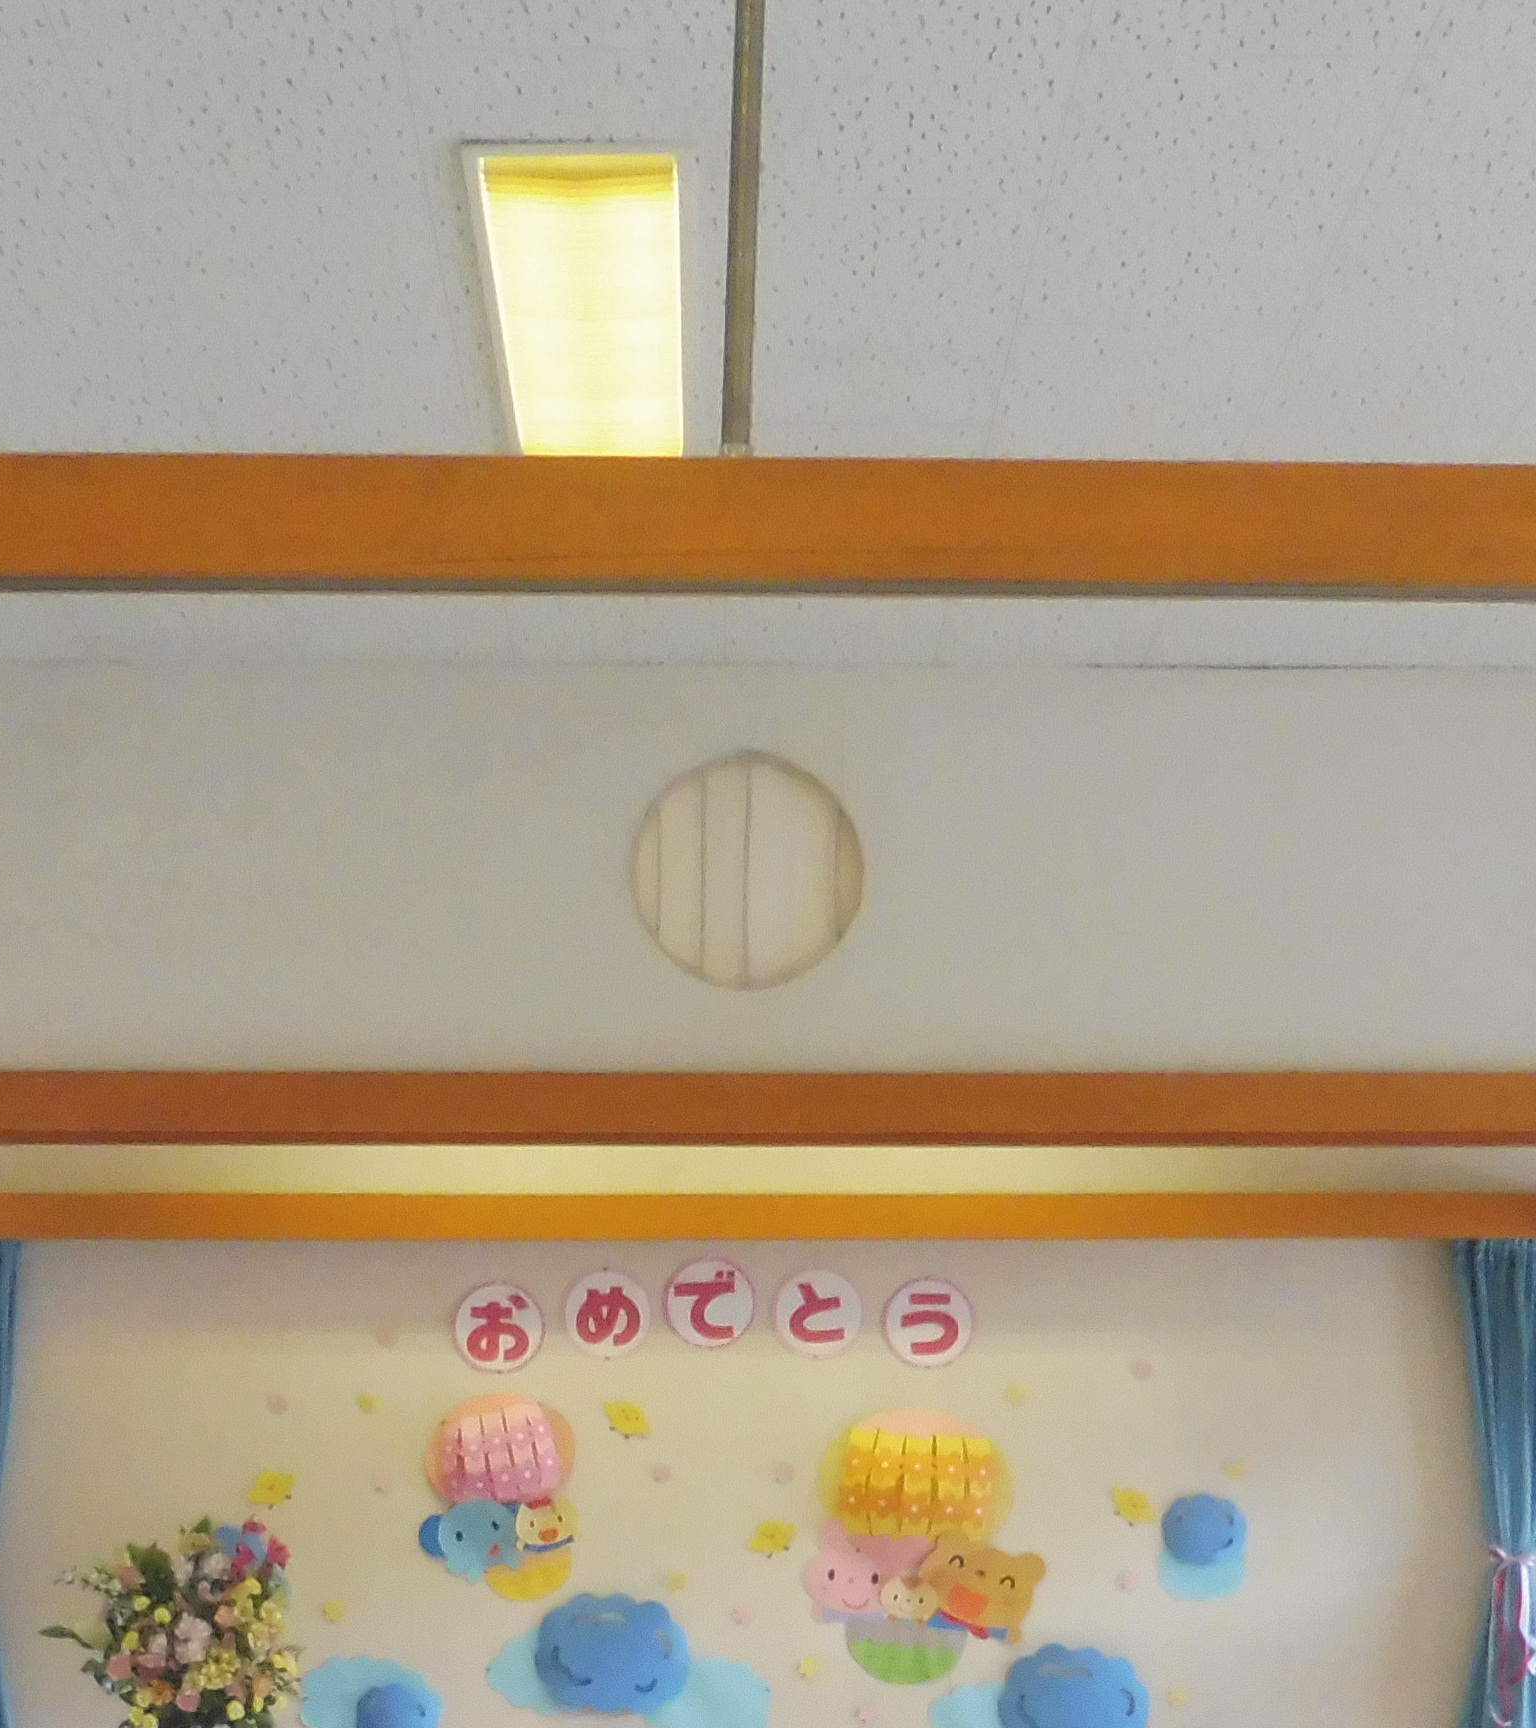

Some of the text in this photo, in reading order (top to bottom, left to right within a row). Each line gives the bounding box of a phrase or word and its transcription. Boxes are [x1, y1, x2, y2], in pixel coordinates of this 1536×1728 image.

[466, 1269, 959, 1363] おめでとう
